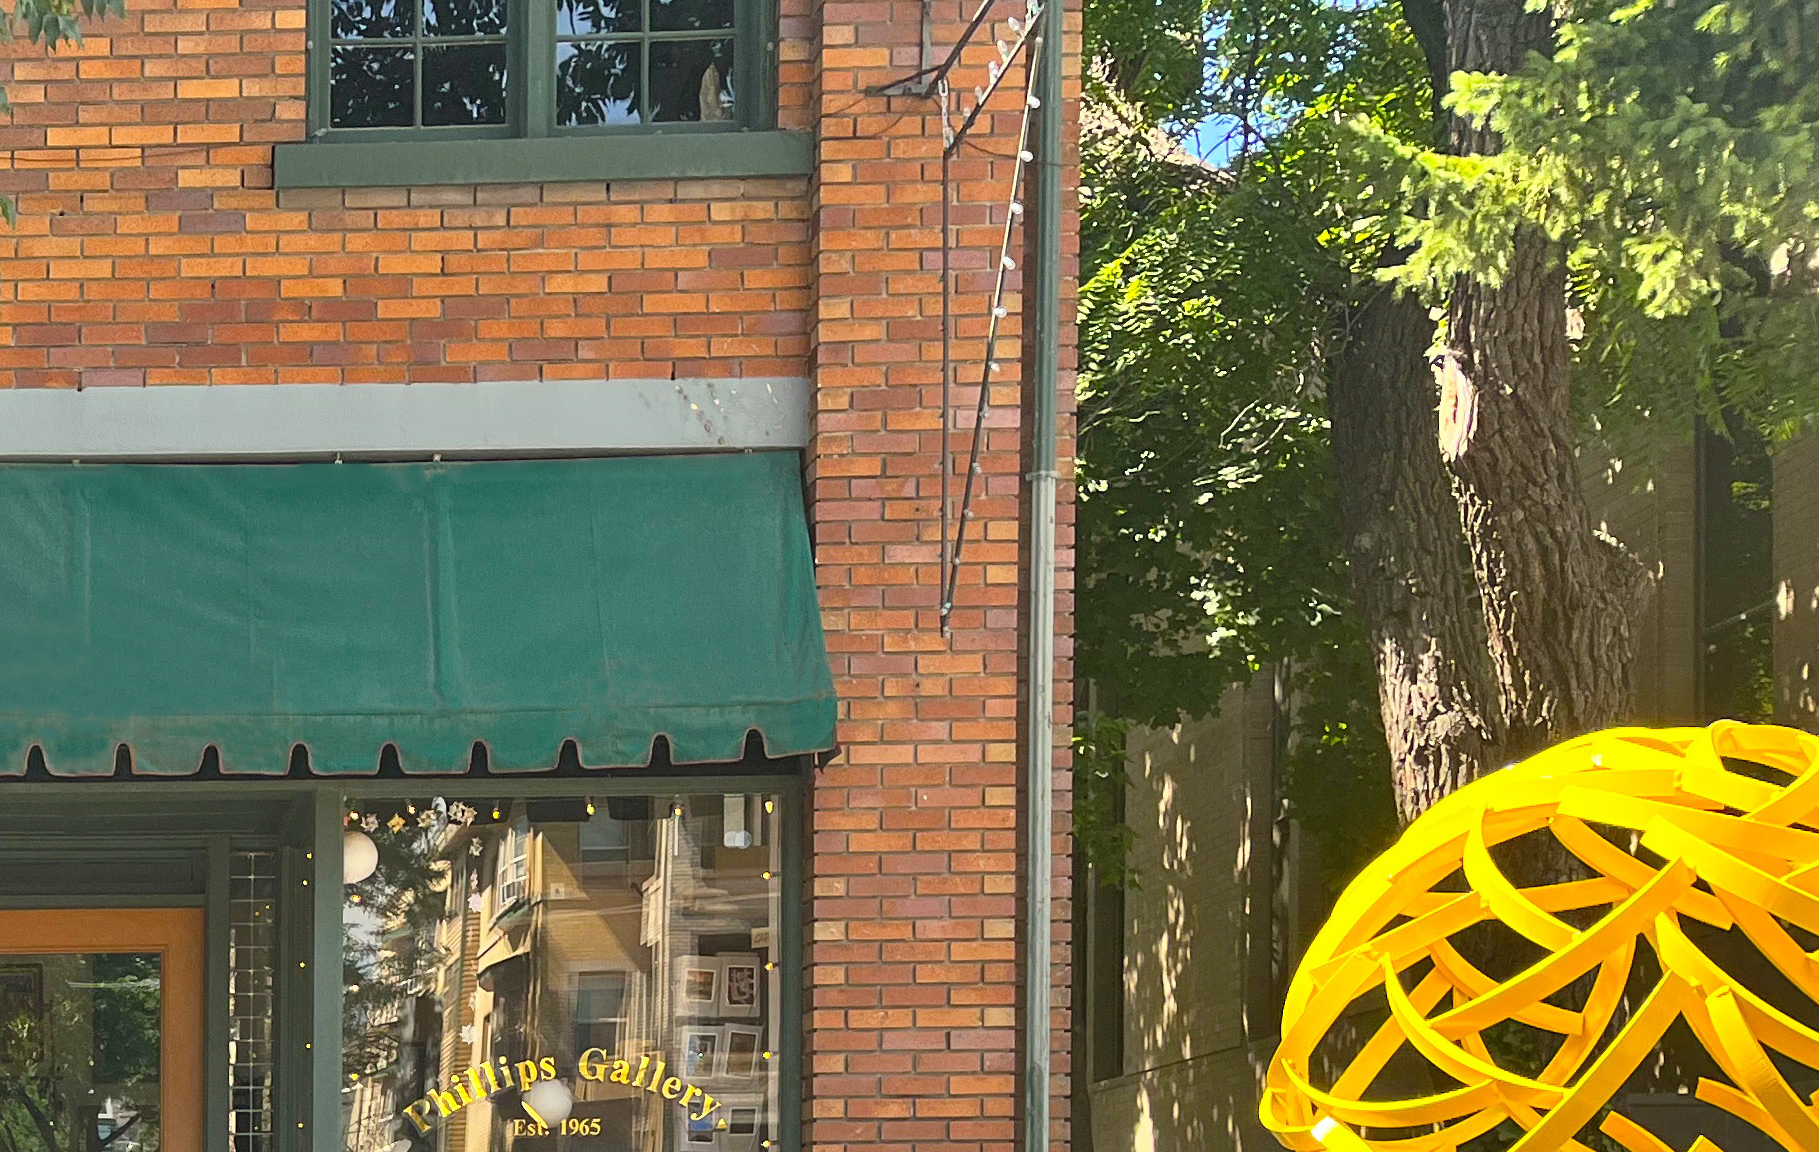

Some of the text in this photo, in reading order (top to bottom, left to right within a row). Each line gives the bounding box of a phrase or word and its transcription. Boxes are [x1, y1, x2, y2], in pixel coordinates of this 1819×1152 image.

[402, 1054, 558, 1134] Phillips
[513, 1117, 602, 1137] Est. 1965
